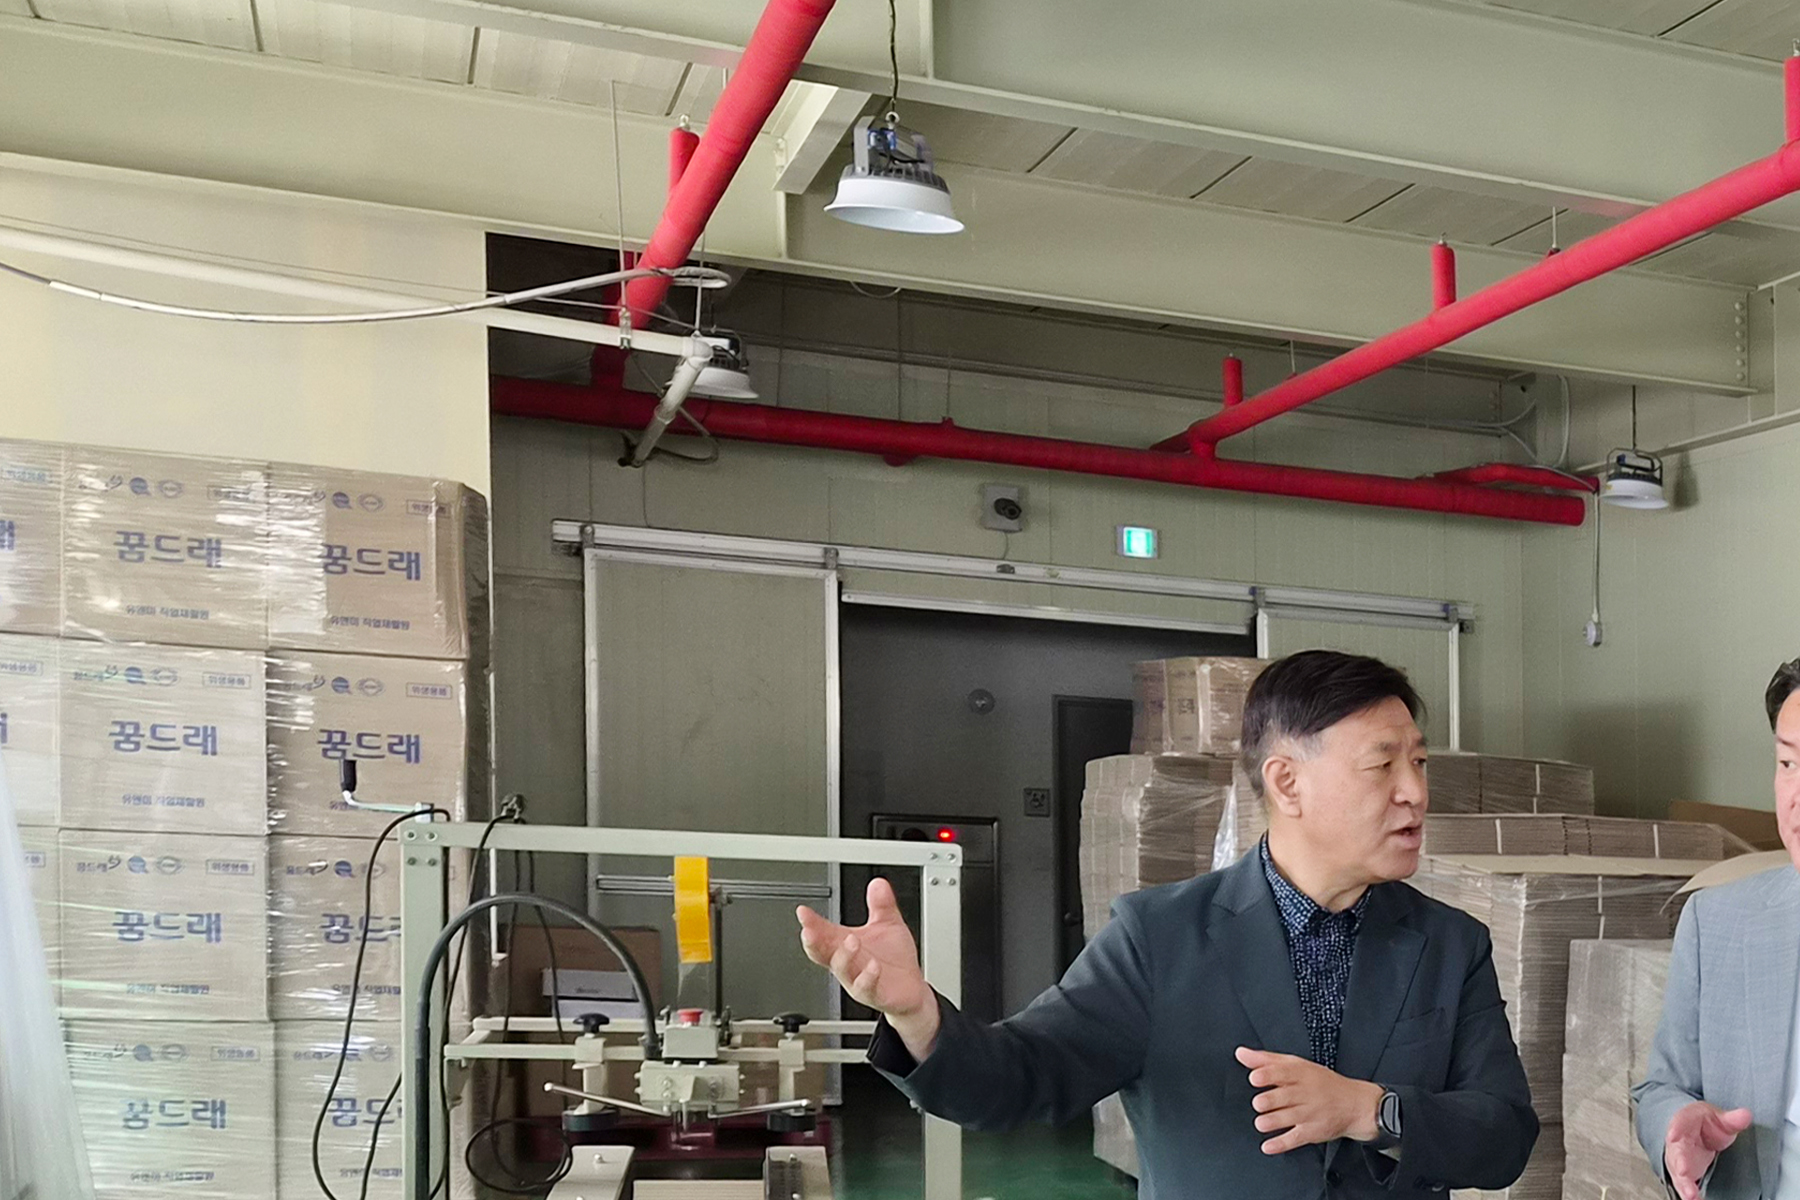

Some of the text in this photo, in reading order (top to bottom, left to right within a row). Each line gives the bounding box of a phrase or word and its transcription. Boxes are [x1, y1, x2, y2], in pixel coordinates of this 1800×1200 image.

[113, 530, 222, 568] 꿈드래
[318, 543, 421, 581] 꿈드래
[363, 617, 411, 631] 직업재활원
[108, 719, 218, 756] 꿈드래
[317, 728, 421, 764] 꿈드래
[112, 911, 222, 943] 꿈드래
[327, 1097, 402, 1128] 꿈드
